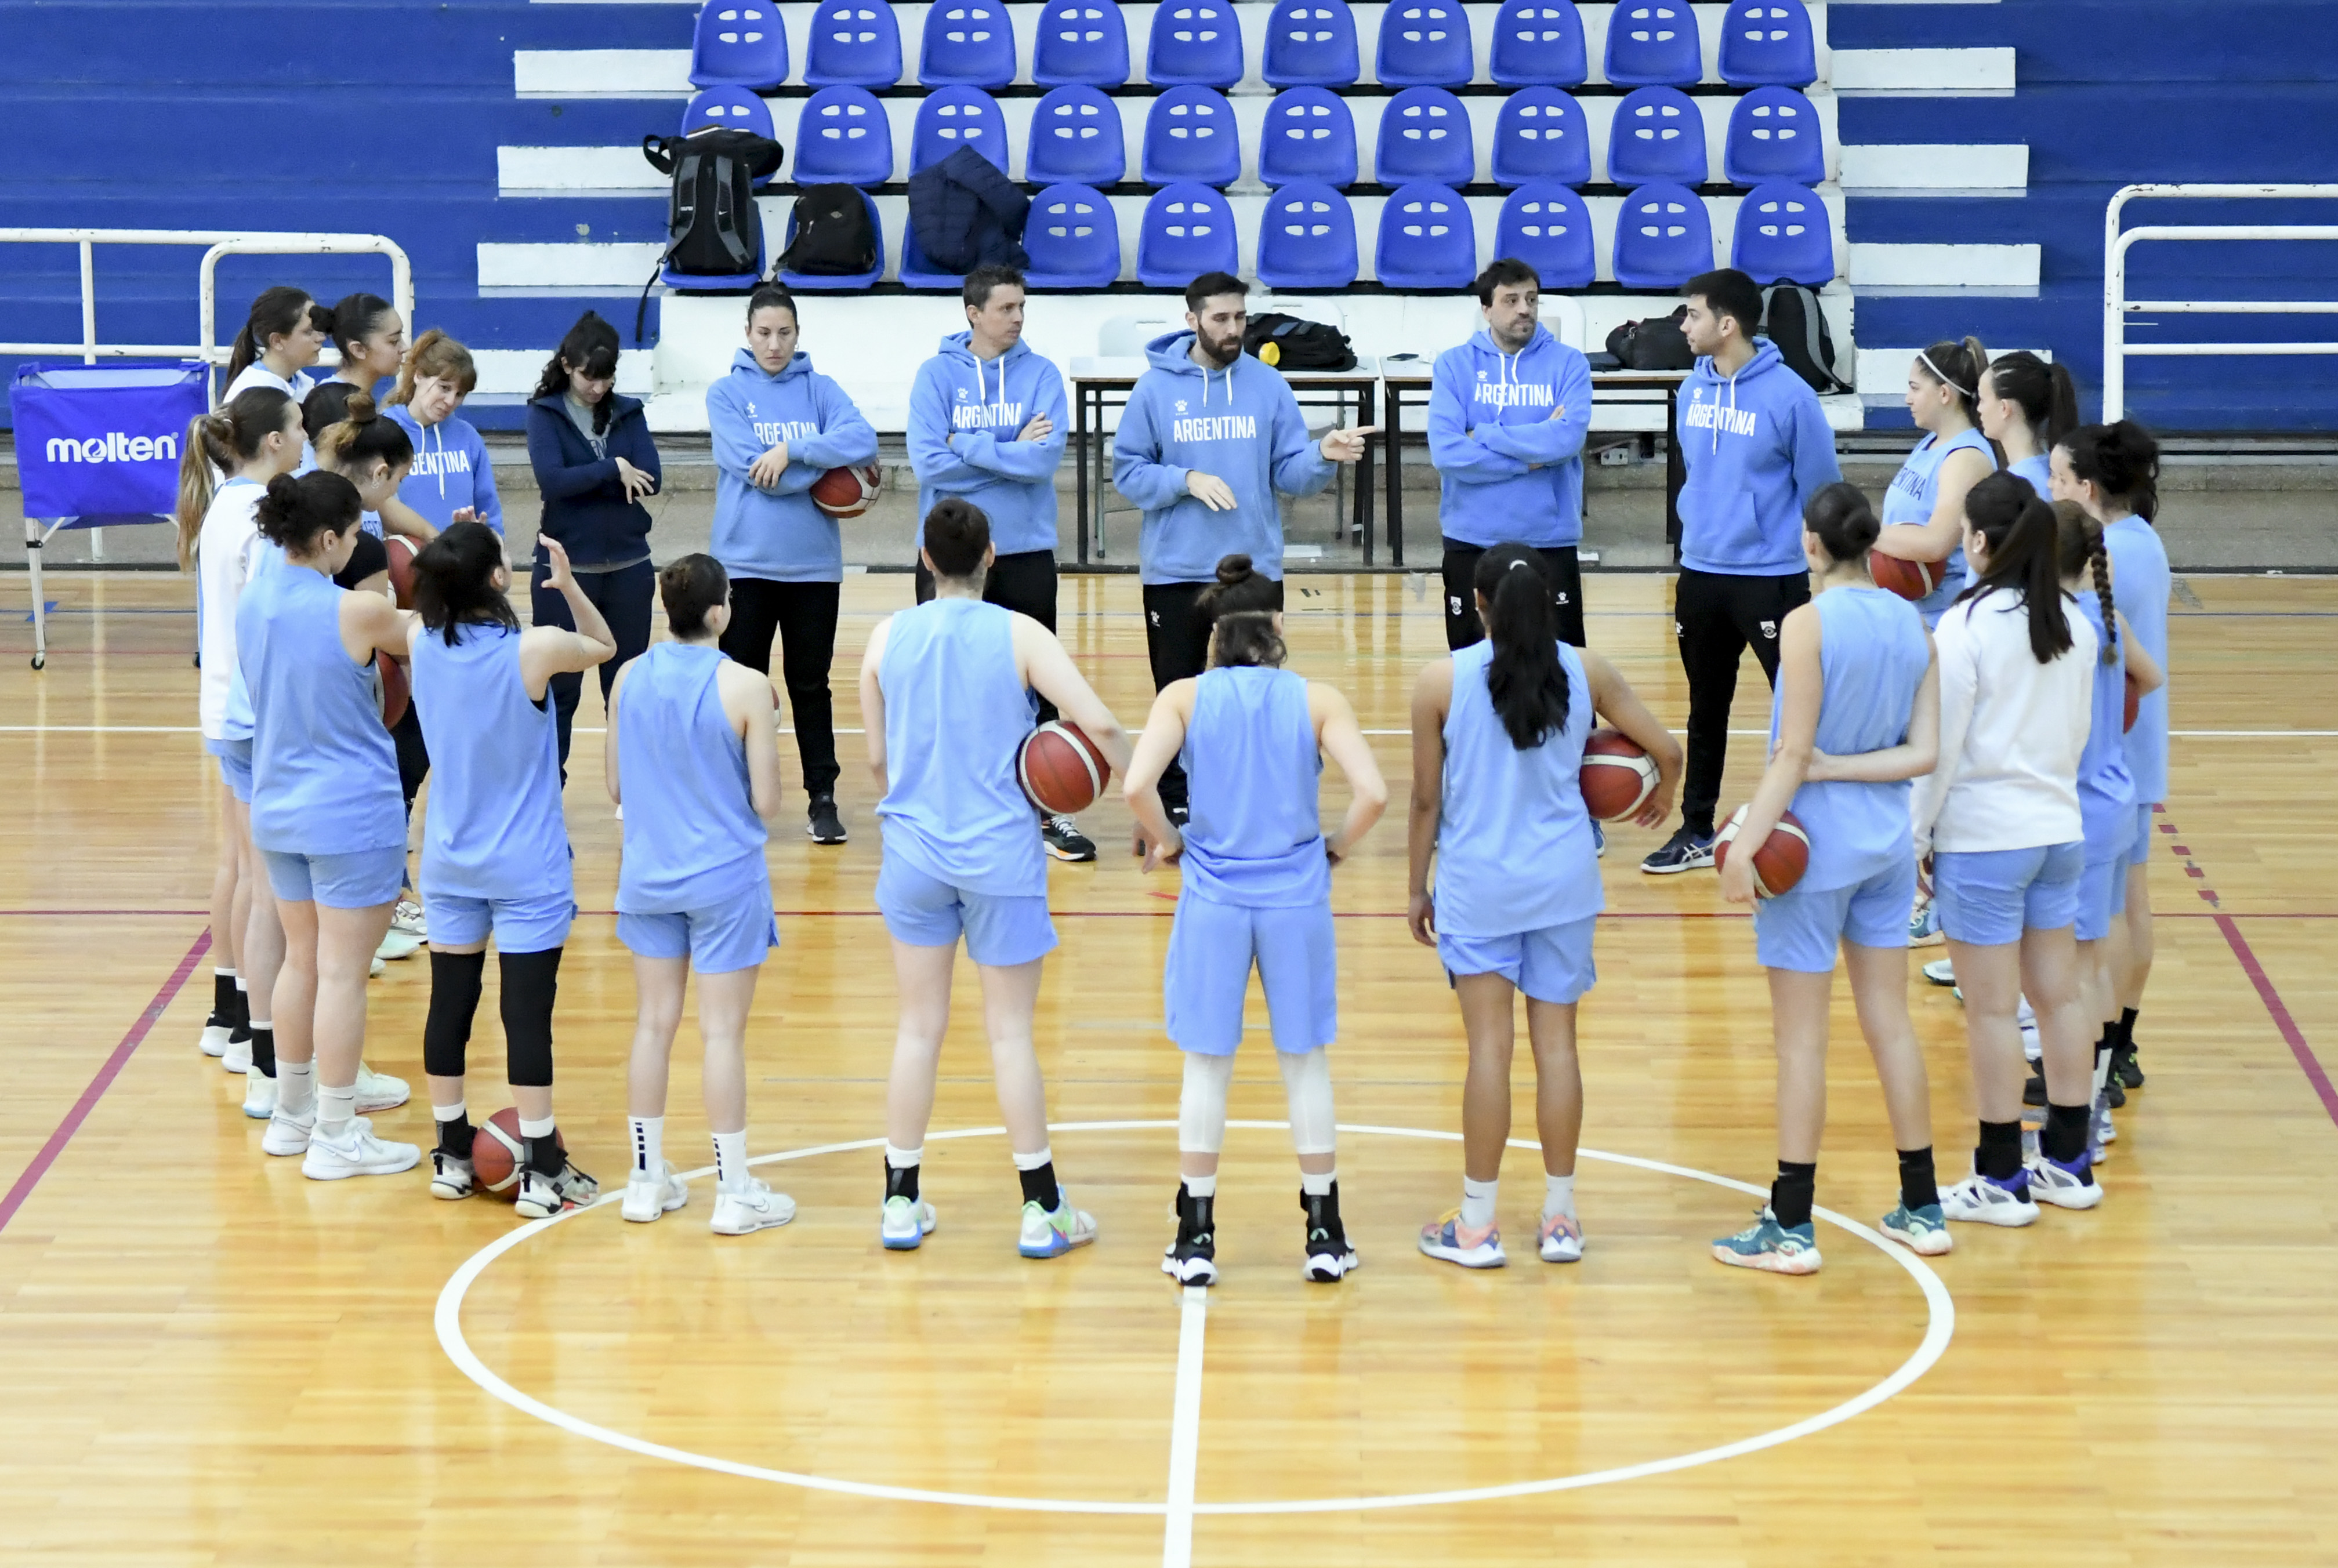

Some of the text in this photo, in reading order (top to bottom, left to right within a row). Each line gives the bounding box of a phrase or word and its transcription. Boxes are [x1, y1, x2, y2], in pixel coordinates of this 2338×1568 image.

[1474, 383, 1554, 407] ARGENTINA
[1174, 415, 1256, 442] ARGENTINA
[1685, 403, 1756, 437] ARGENTINA
[46, 431, 176, 463] molten
[409, 449, 470, 476] GENTINA
